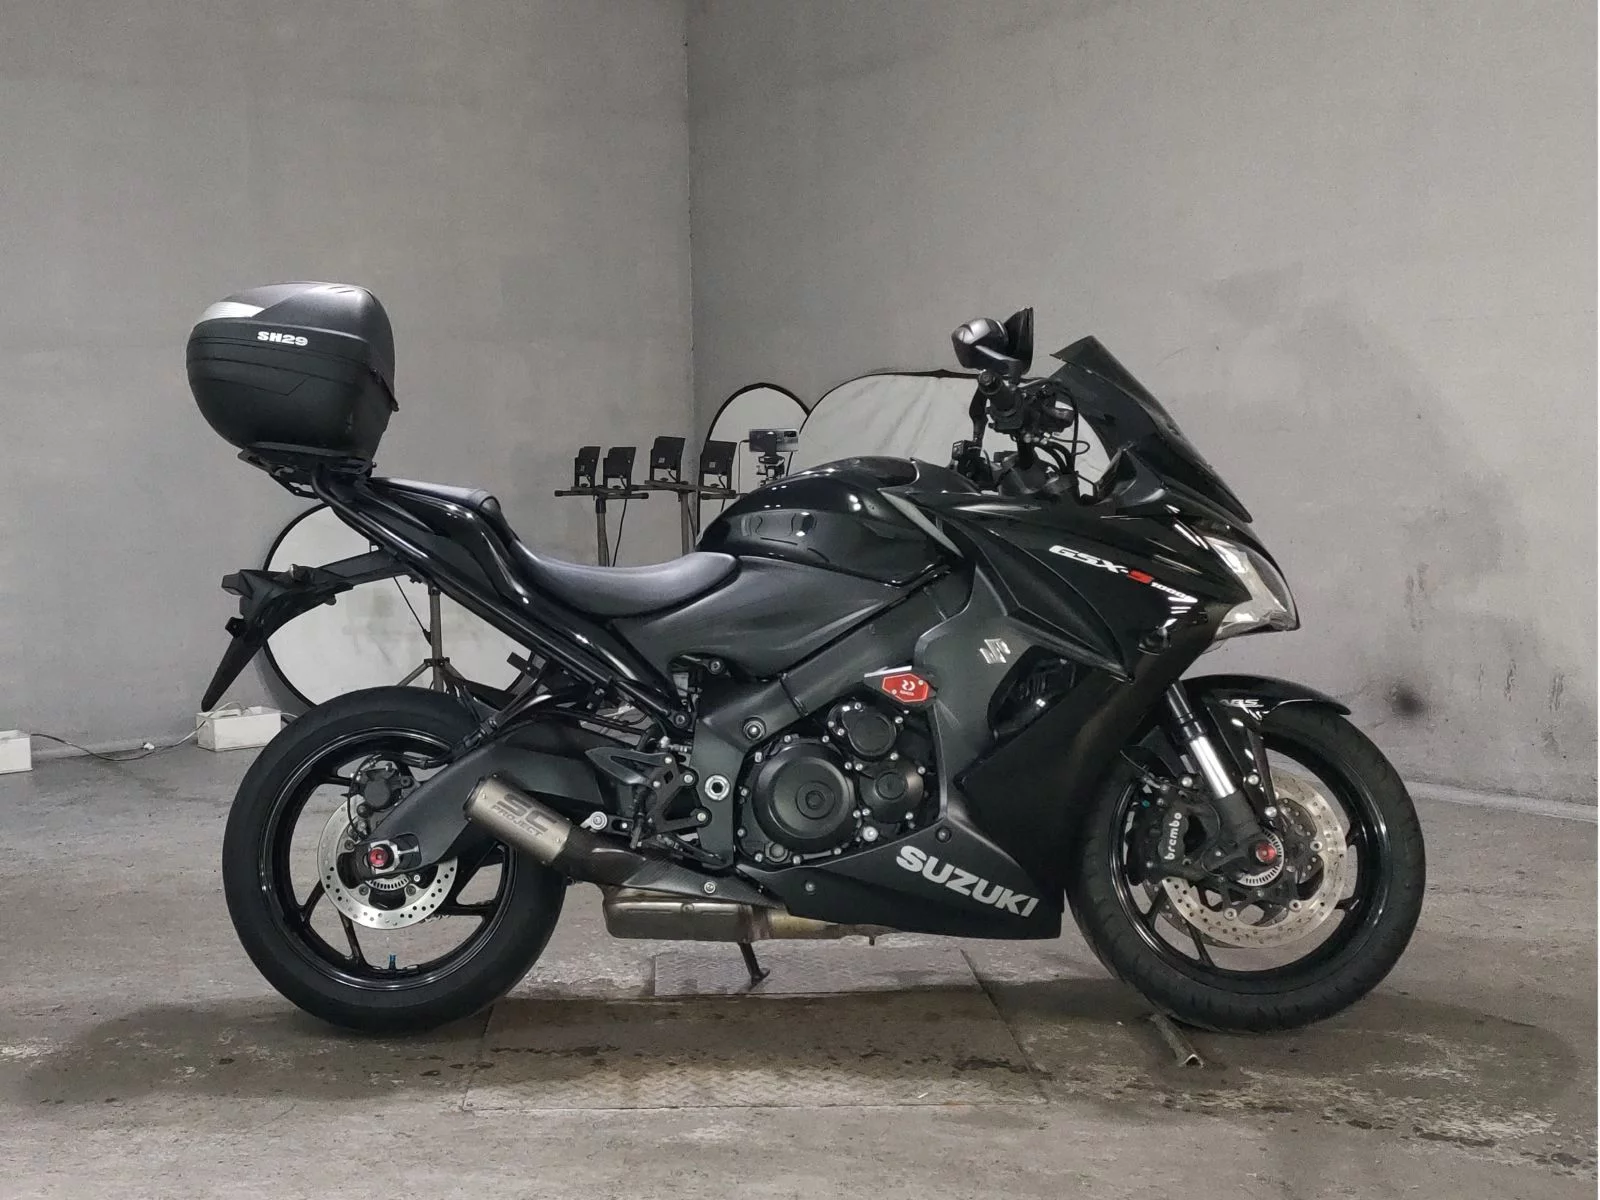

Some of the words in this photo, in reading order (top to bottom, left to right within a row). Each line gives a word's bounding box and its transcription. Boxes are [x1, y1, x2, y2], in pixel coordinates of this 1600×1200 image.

[257, 331, 308, 346] SH29
[490, 803, 544, 838] PROJECT
[496, 792, 558, 833] SC
[1163, 812, 1182, 860] brembo
[896, 845, 1040, 917] SUZUKI
